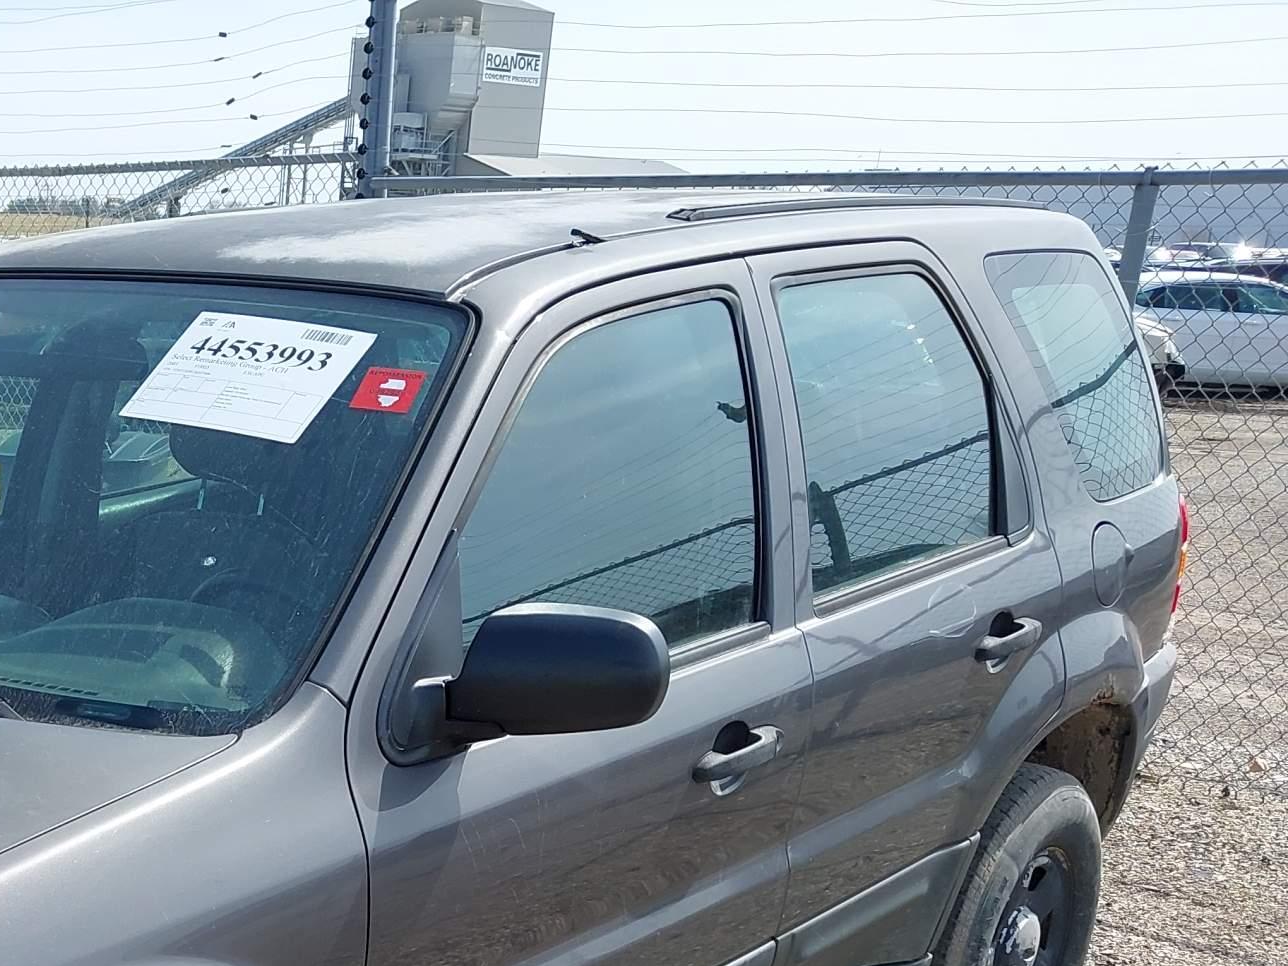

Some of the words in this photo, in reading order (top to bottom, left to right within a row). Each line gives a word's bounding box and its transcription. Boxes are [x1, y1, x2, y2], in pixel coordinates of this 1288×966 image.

[486, 53, 541, 72] ROANOKE
[484, 72, 511, 81] CONCRETE
[190, 336, 333, 371] 44553993
[194, 356, 238, 368] Remarketing
